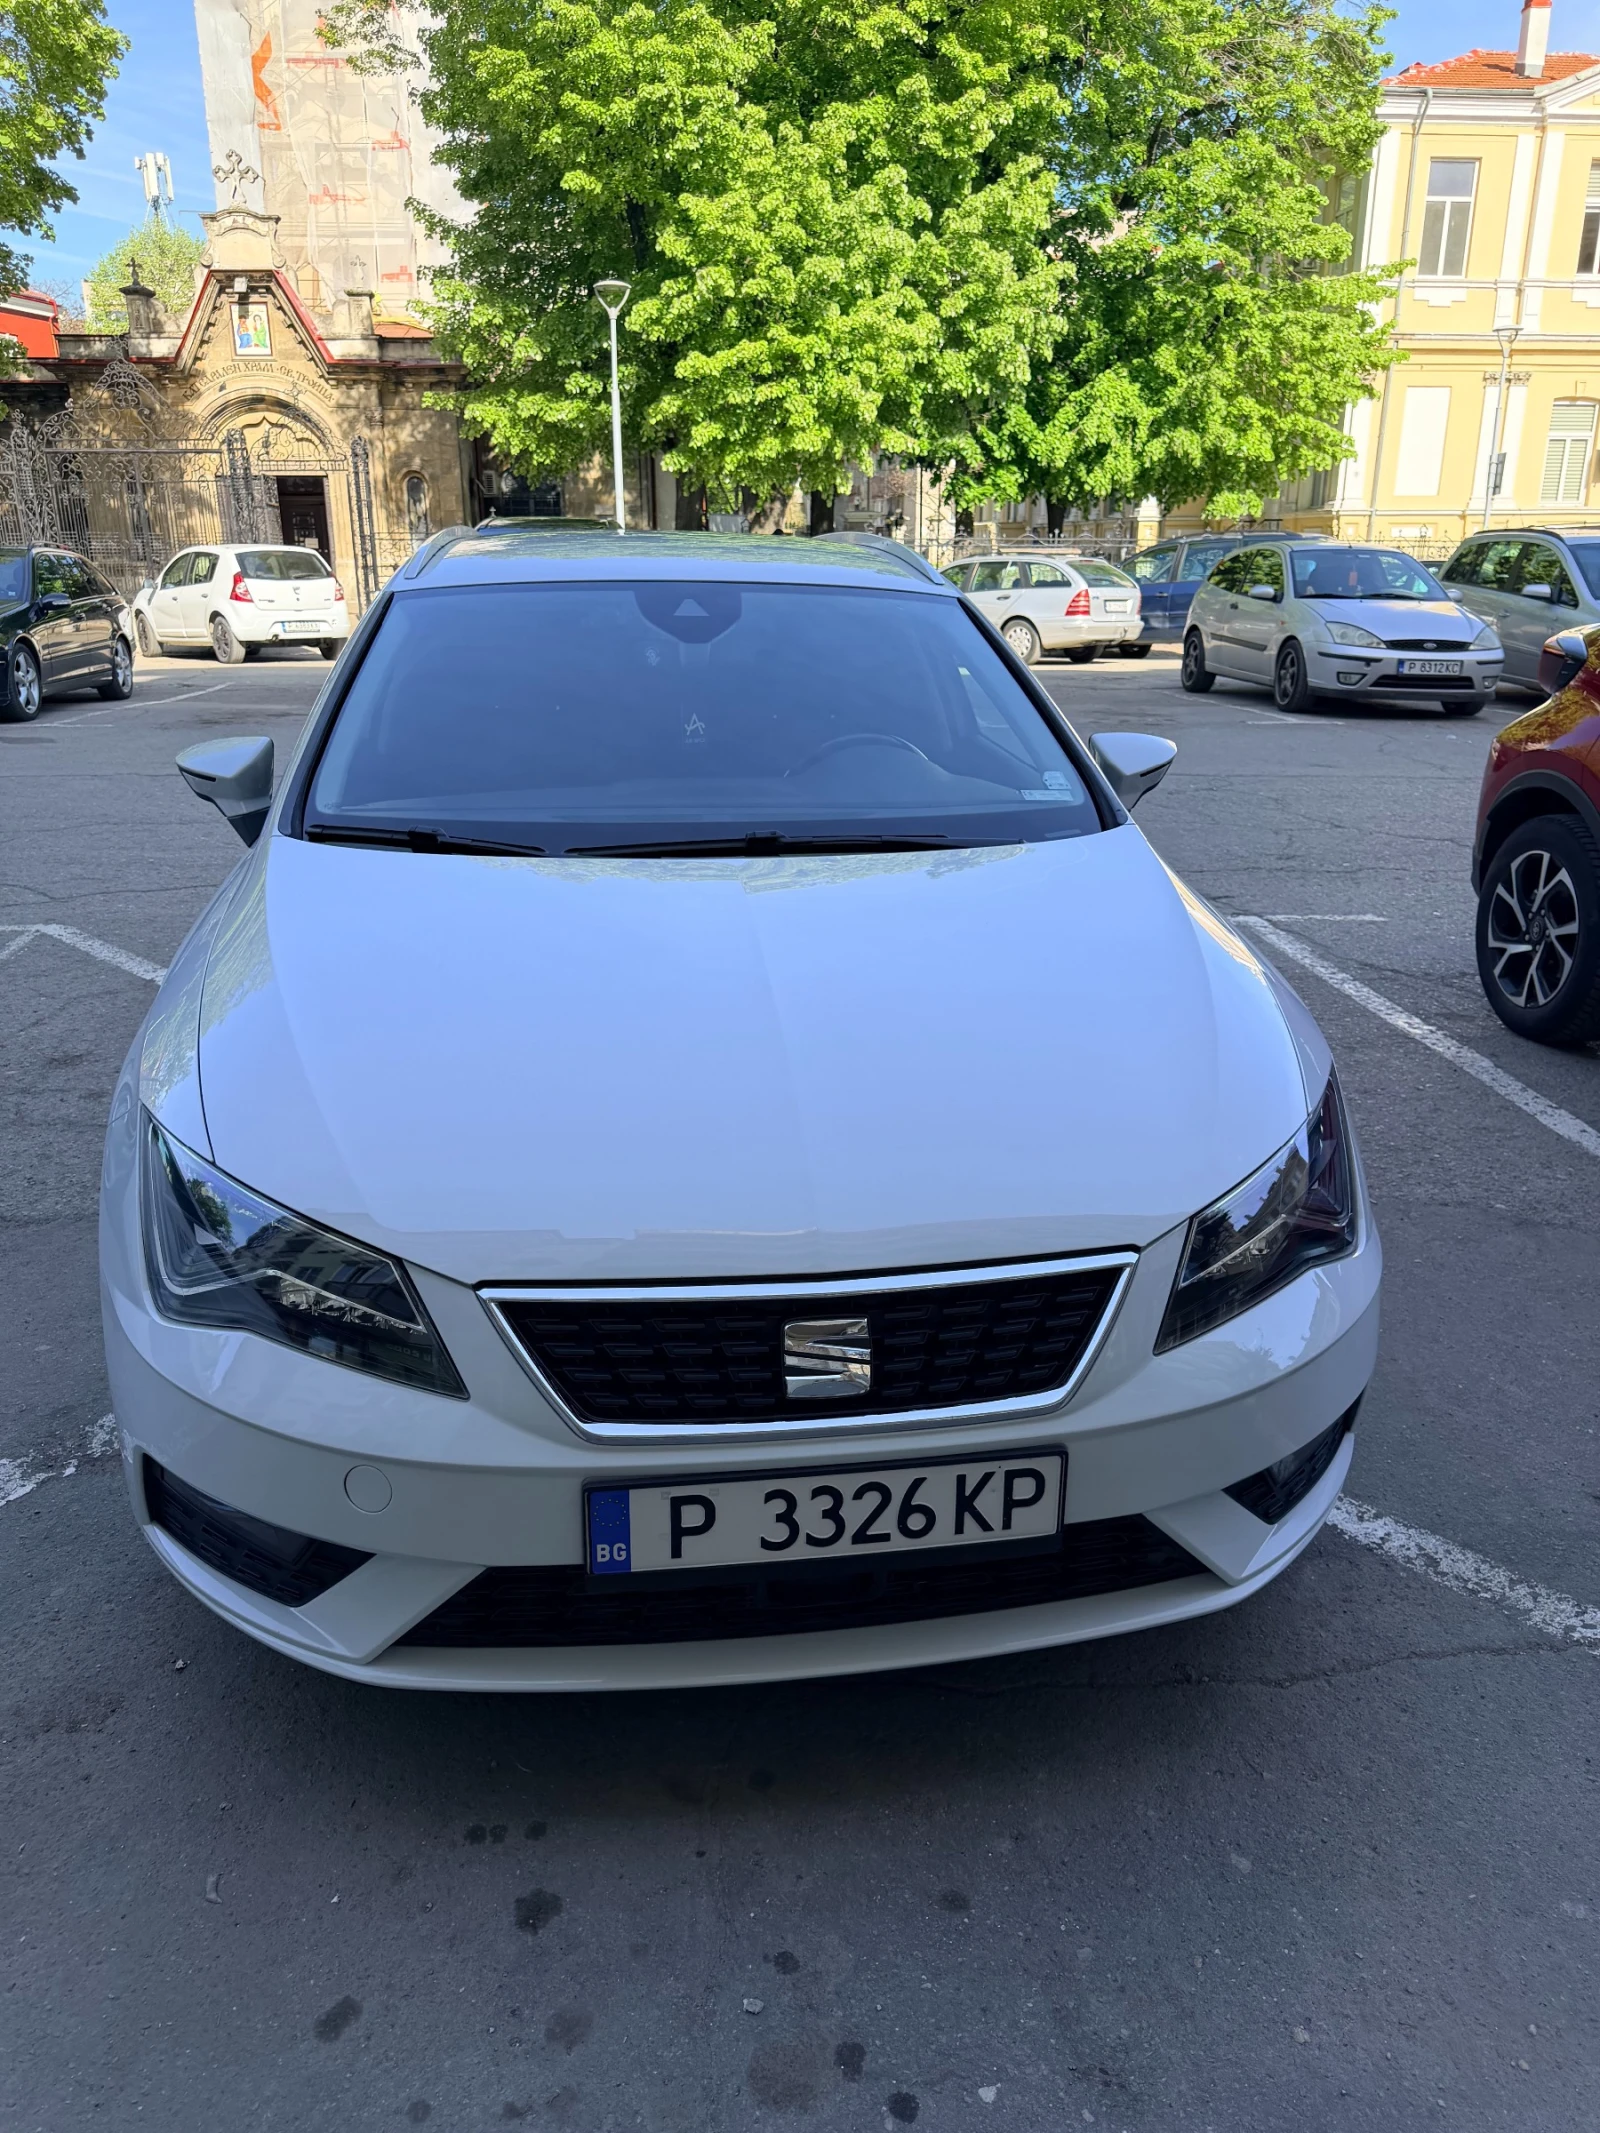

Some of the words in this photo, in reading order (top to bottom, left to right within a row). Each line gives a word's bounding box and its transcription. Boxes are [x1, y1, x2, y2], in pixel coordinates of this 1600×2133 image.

[670, 1494, 717, 1560] P
[760, 1477, 937, 1552] 3326
[953, 1467, 1046, 1536] KP
[596, 1543, 627, 1562] BG
